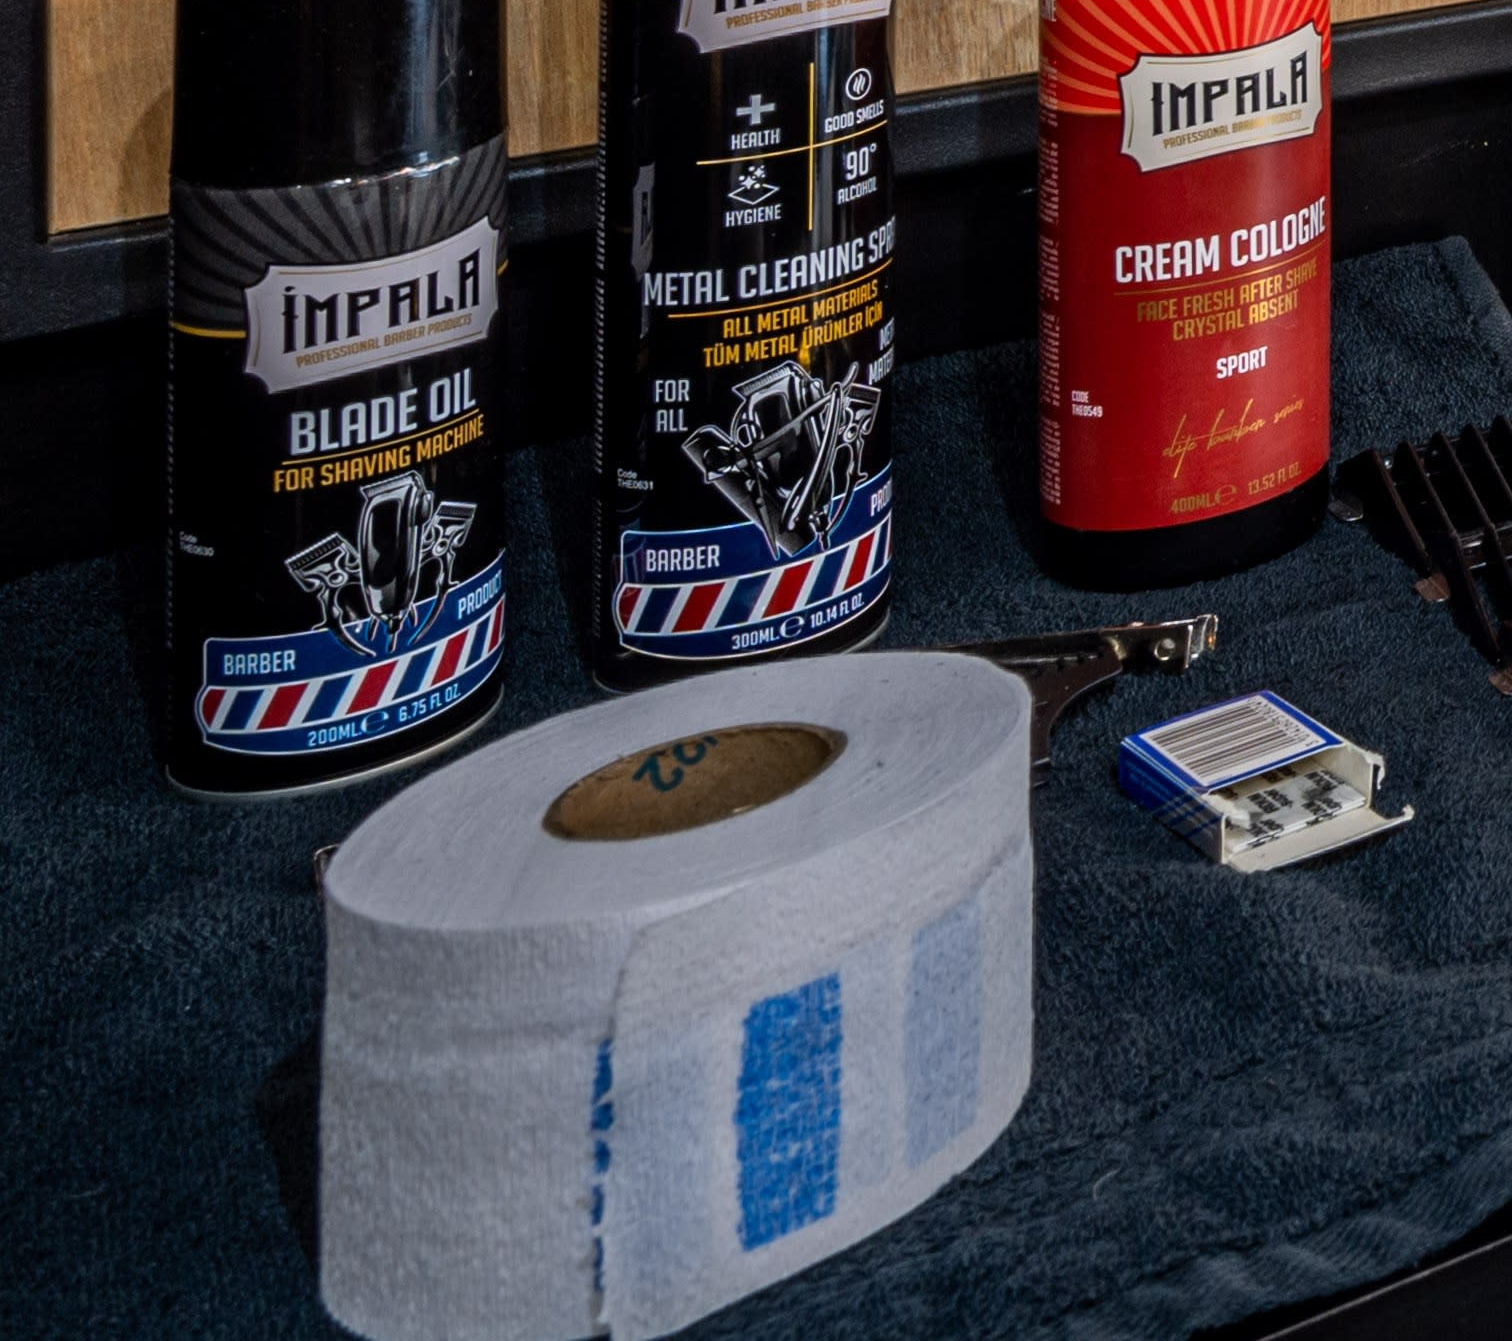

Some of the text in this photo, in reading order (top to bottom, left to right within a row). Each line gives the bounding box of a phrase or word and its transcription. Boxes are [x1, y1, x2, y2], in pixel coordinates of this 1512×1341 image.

[726, 2, 804, 30] PROFESSIONAL
[1151, 50, 1308, 137] IMPALA
[824, 99, 885, 134] GOOD SMELLS
[731, 128, 781, 151] HEALTH
[1163, 124, 1230, 150] PROFESSIONAL
[837, 176, 878, 205] ALCOHOL
[725, 204, 782, 228] HYGIENE
[1114, 195, 1326, 284] CREAM COLOGNE
[644, 236, 865, 306] METAL CLEANING
[1136, 256, 1319, 324] FACE FRESH AFTER SHAVE
[723, 279, 879, 340] ALL METAL MATERIALS
[1172, 290, 1300, 342] CRYSTAL ABSENT
[295, 313, 473, 369] PROFESSIONAL BARBER PRODUCTS
[703, 341, 741, 368] TÜM
[744, 334, 799, 363] METAL
[802, 311, 864, 349] ÜRÜNLER
[1216, 345, 1268, 380] SPORT
[655, 379, 690, 404] FOR
[1071, 390, 1090, 404] CODE
[290, 368, 477, 457] BLADE OIL
[655, 409, 688, 433] ALL
[273, 414, 485, 494] FOR SHAVING MACHINE
[617, 468, 638, 479] Code
[1247, 471, 1276, 494] 13.52
[646, 544, 721, 572] BARBER
[810, 603, 850, 629] 10.14 FL
[223, 649, 297, 677] BARBER
[398, 694, 443, 724] 6.75 FL
